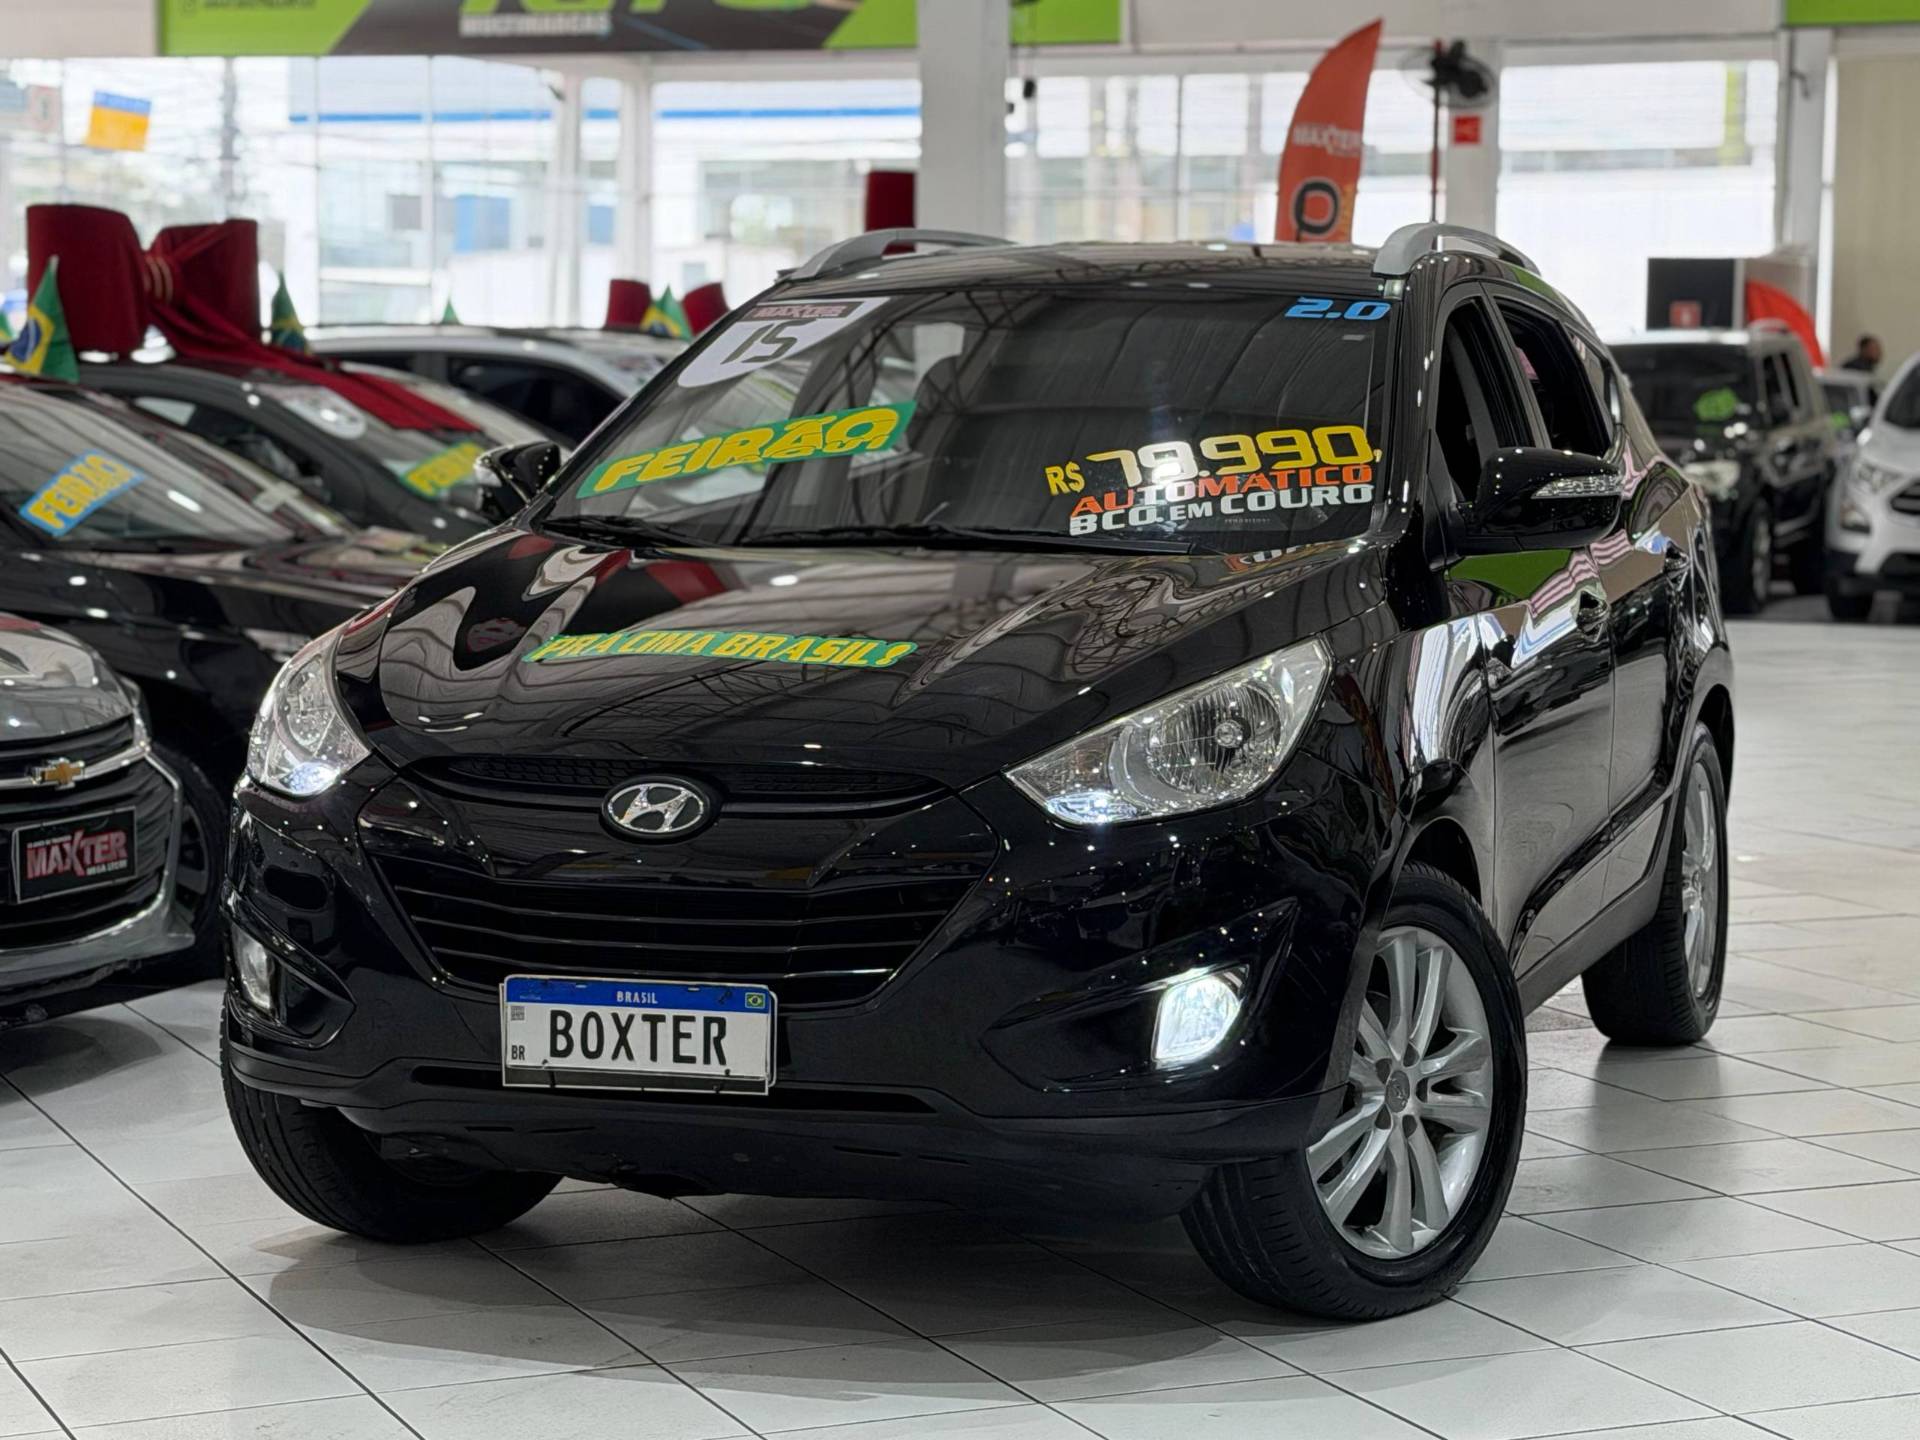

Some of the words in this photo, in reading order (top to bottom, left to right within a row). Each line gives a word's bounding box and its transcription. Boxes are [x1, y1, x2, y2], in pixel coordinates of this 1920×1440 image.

[1284, 297, 1391, 320] 2.0
[721, 319, 817, 364] 15
[594, 408, 899, 492] FEIRÃO
[1045, 461, 1085, 495] R$
[1070, 465, 1373, 517] AUTOMATICO
[1170, 501, 1212, 521] EM
[1220, 484, 1374, 515] COURO
[617, 631, 716, 655] CIMA
[27, 829, 128, 879] MAXTER
[616, 991, 658, 1004] BRASIL
[511, 1045, 525, 1060] BR
[549, 1009, 727, 1066] BOXTER
